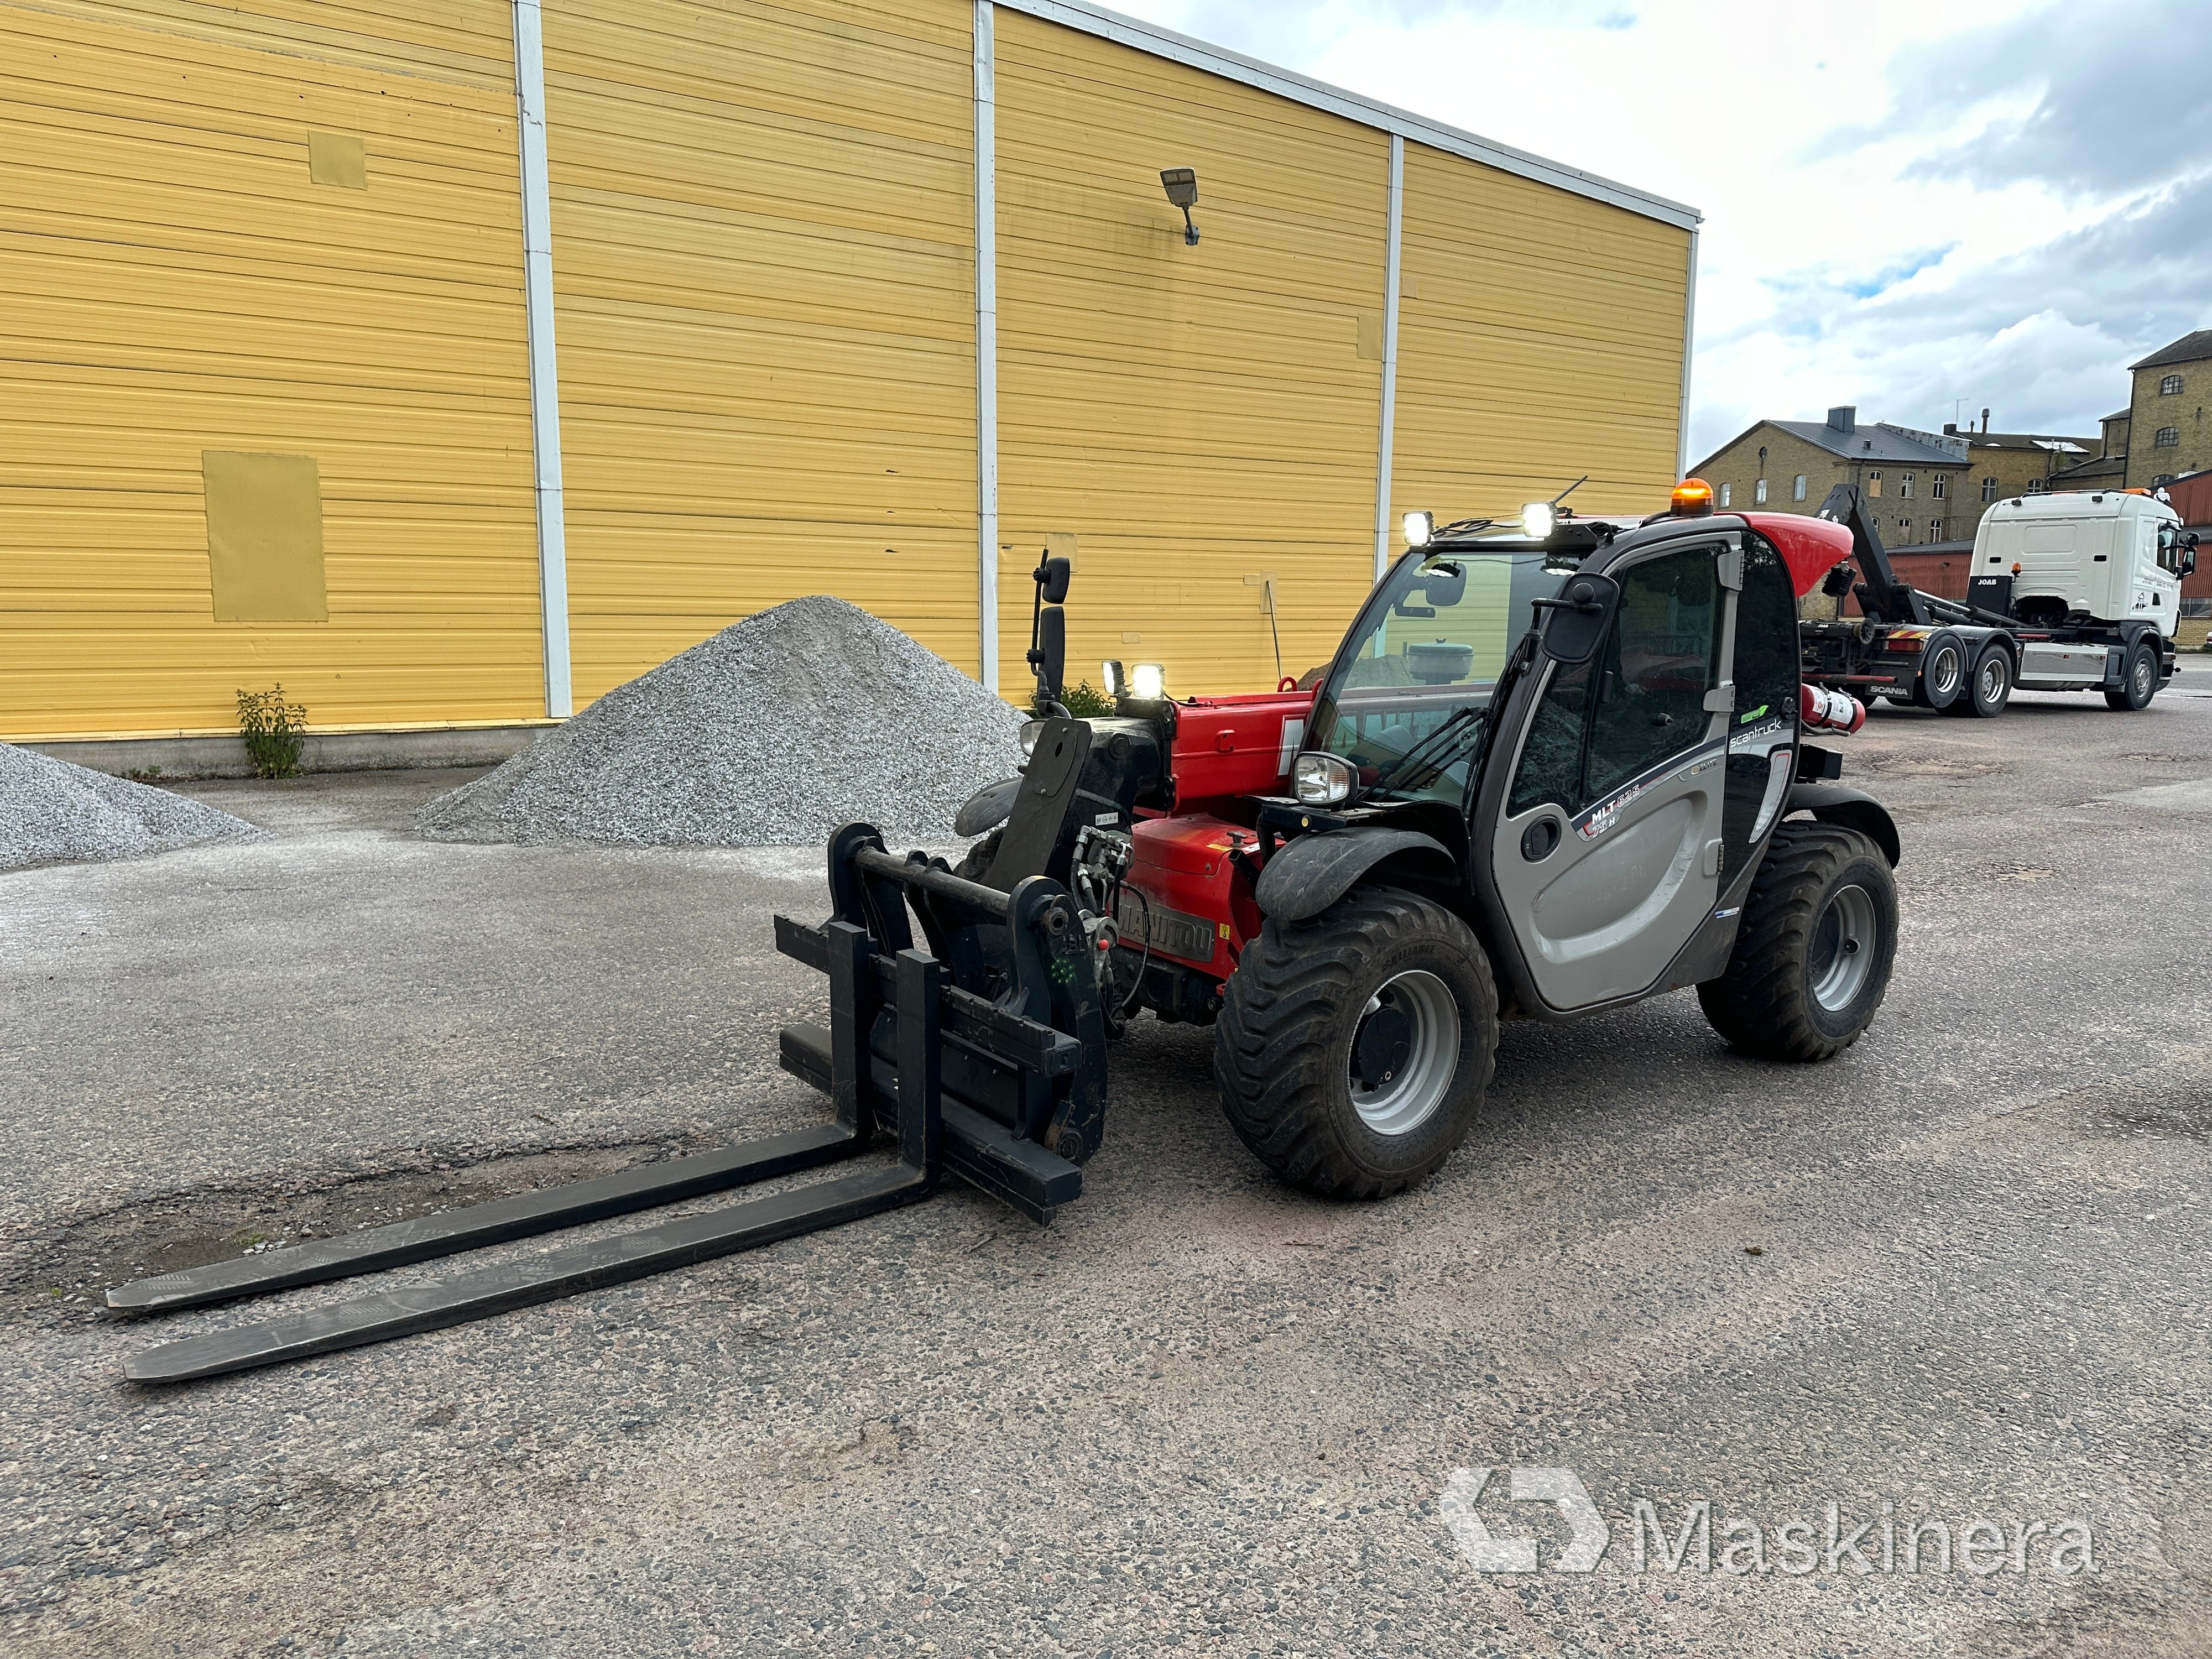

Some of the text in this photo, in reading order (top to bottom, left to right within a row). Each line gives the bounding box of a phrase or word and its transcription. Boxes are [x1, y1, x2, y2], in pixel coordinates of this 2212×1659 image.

[1870, 685, 1908, 696] SCANIA
[1730, 718, 1782, 748] scantruck
[1592, 784, 1640, 825] MLT 625
[1593, 816, 1615, 838] 75 H
[1118, 902, 1213, 955] MANITOU
